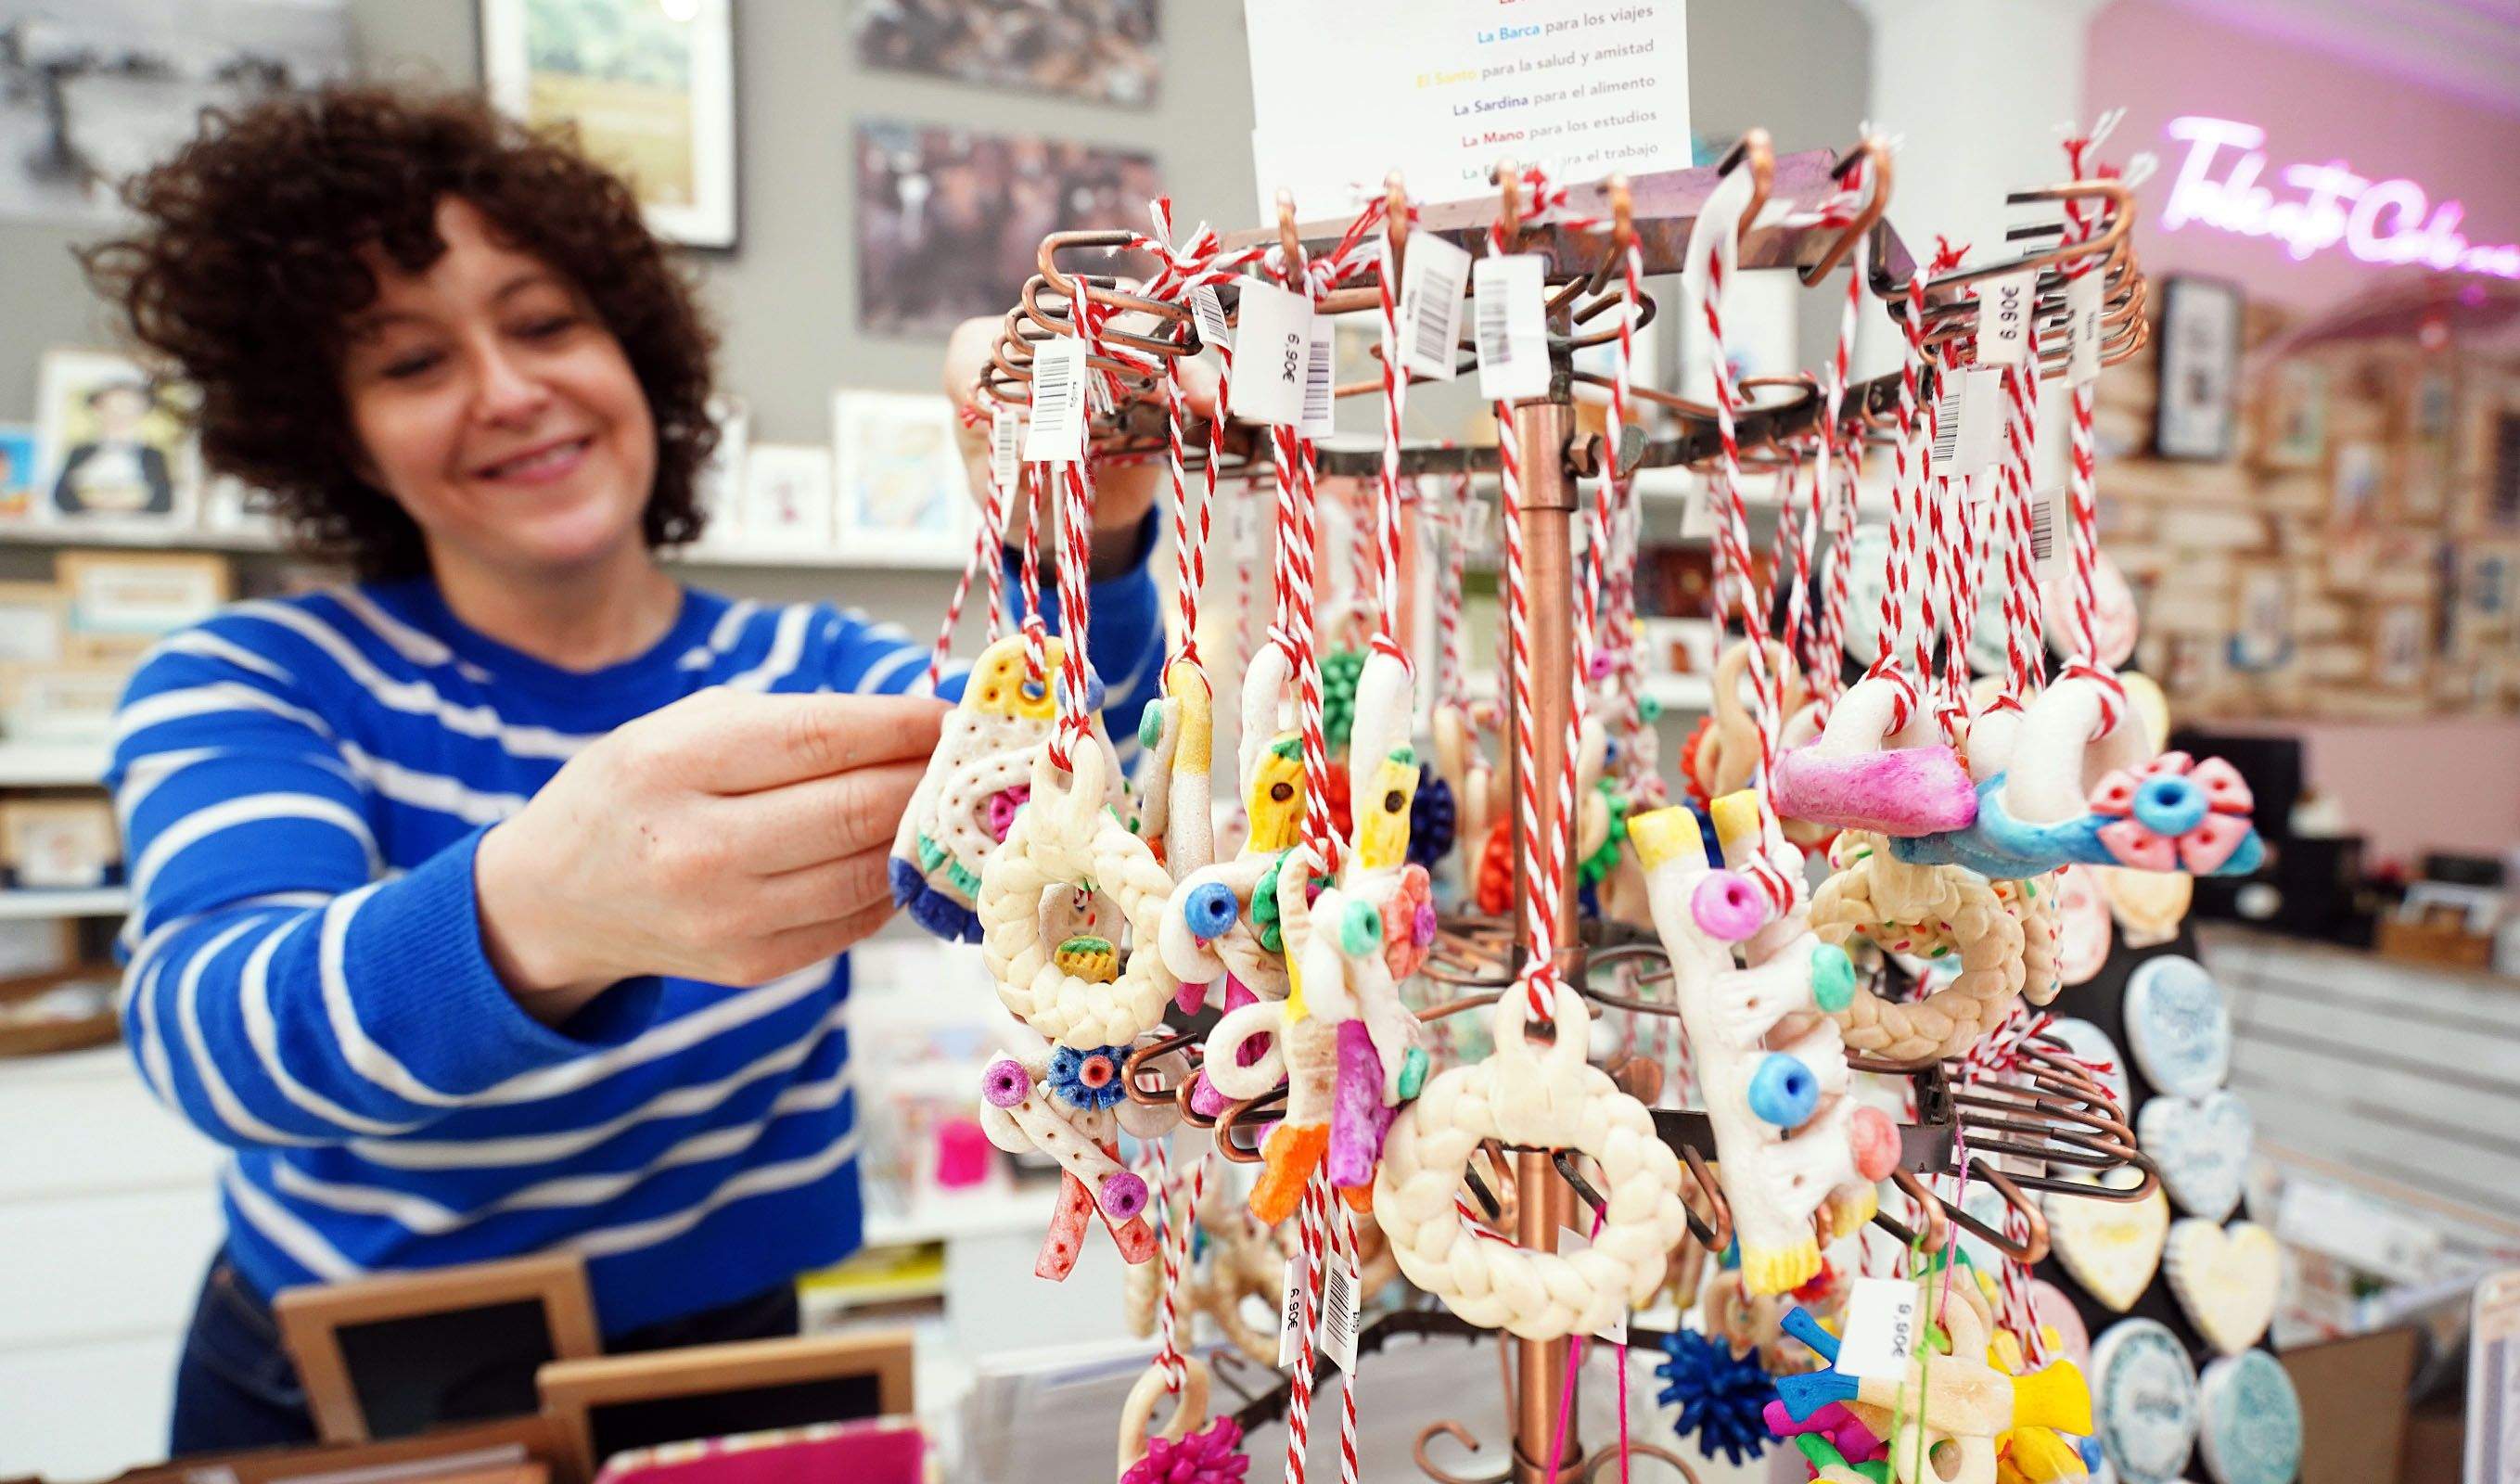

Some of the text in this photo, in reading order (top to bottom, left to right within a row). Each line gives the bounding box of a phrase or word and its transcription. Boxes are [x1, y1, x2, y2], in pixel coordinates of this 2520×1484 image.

[1477, 5, 1654, 44] La Barca para los viajes
[1482, 63, 1515, 81] para
[1519, 58, 1532, 73] la
[1537, 50, 1576, 70] salud
[1580, 52, 1590, 67] y
[1594, 38, 1654, 61] amistad
[1453, 76, 1657, 117] La Sardina para el alimento
[1462, 109, 1657, 148] La Mano para los estudios
[1462, 168, 1478, 181] La
[1587, 149, 1600, 163] el
[1605, 141, 1659, 163] trabajo
